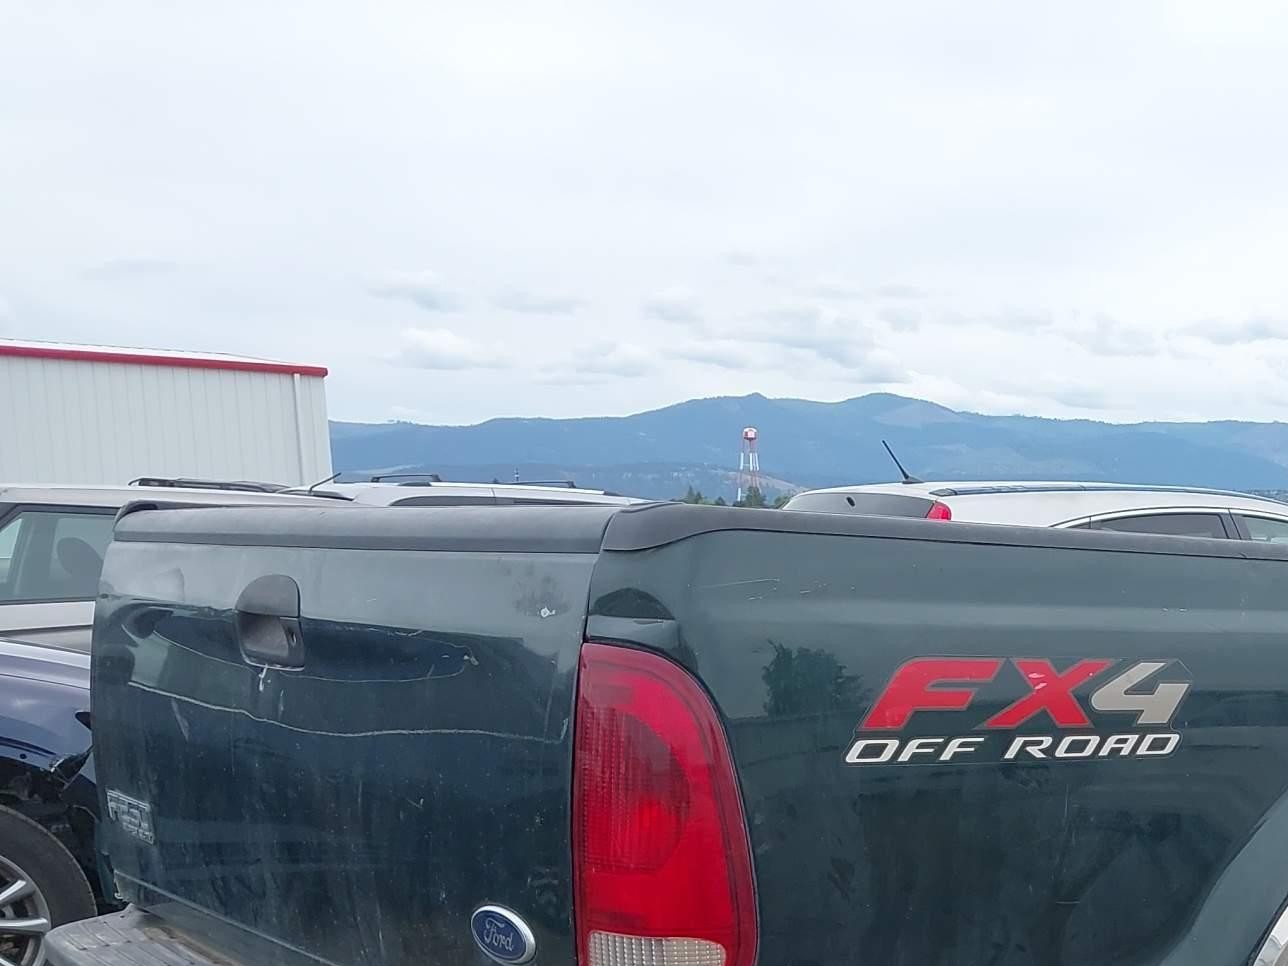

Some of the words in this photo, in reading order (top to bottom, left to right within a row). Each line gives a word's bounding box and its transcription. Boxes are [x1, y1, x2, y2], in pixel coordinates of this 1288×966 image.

[859, 656, 1191, 729] FX4
[845, 737, 985, 764] OFF
[1003, 733, 1181, 759] ROAD
[483, 916, 515, 952] Ford
